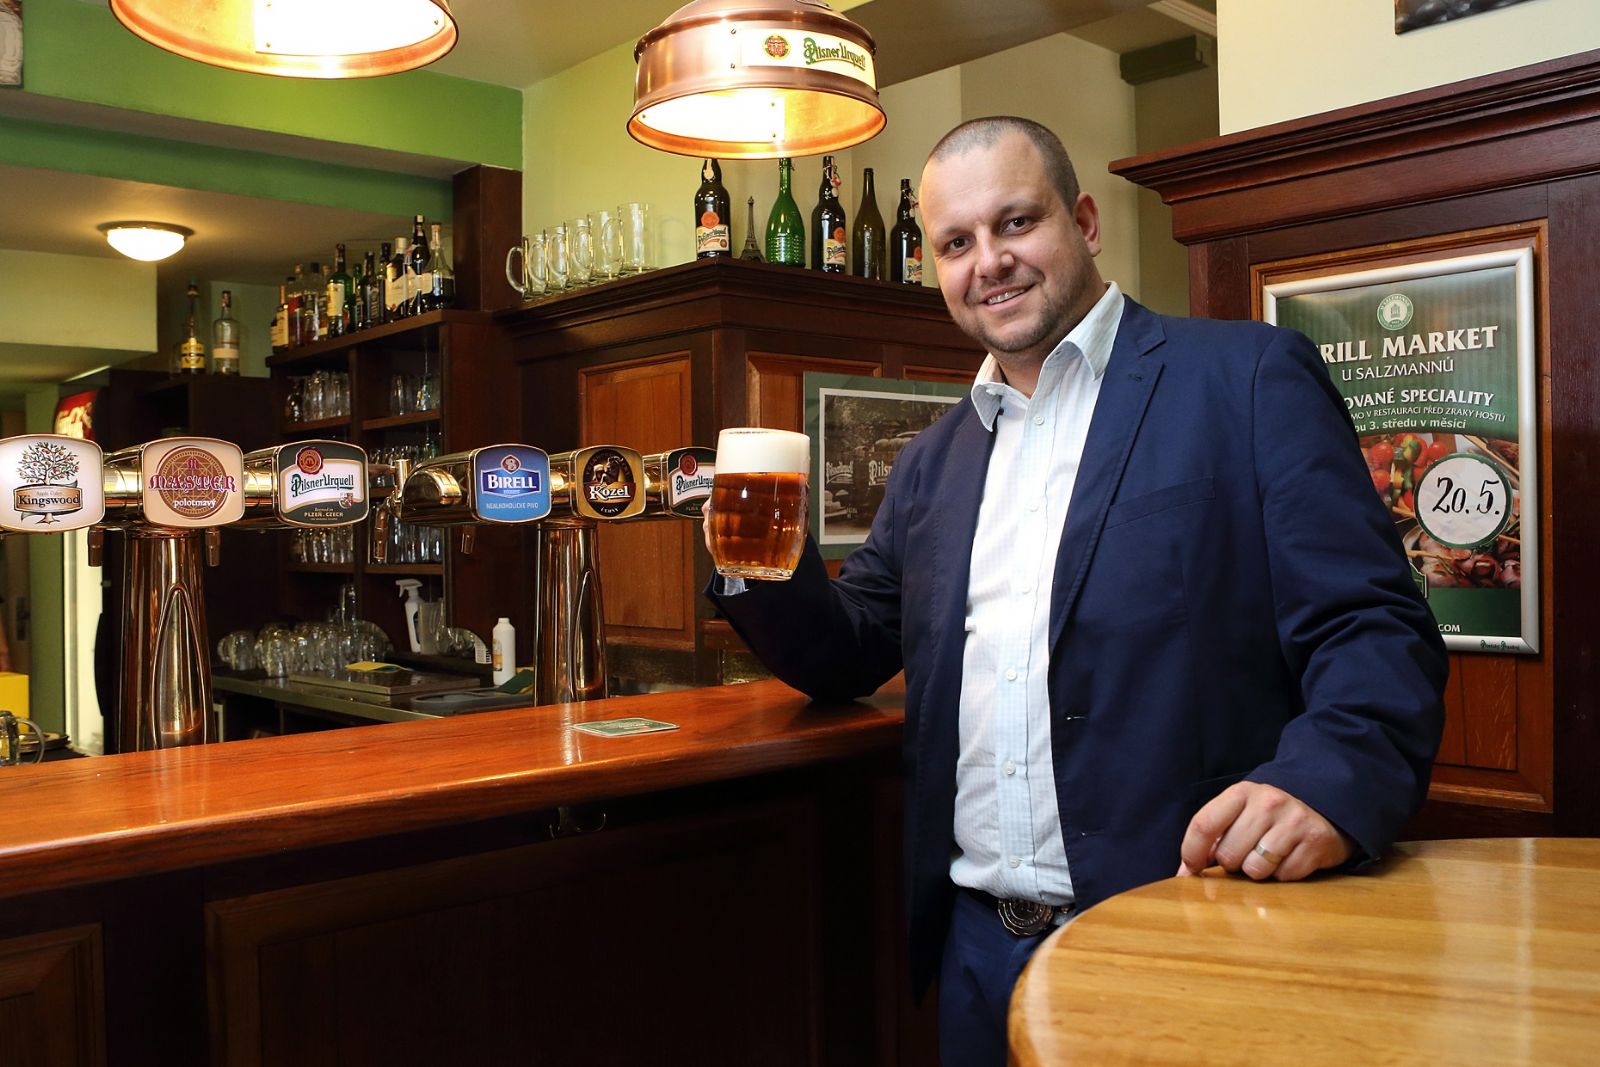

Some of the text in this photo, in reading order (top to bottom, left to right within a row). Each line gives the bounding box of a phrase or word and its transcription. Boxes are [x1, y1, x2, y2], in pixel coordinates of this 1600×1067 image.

[803, 37, 840, 65] Pilsner
[1316, 325, 1498, 364] RILL MARKET
[1400, 388, 1495, 407] SPECIALITY
[1373, 406, 1421, 417] RESTAURACI
[1445, 407, 1474, 417] ZRAKY
[1369, 421, 1380, 431] 3.
[1382, 417, 1417, 429] středu
[1429, 417, 1467, 429] měsíci
[149, 474, 237, 493] MASTER
[291, 473, 355, 498] Pilsner Urquell
[487, 474, 537, 489] BIRELL
[676, 475, 699, 495] Pilsner
[18, 495, 80, 508] Kingswood
[589, 485, 631, 501] Kozel
